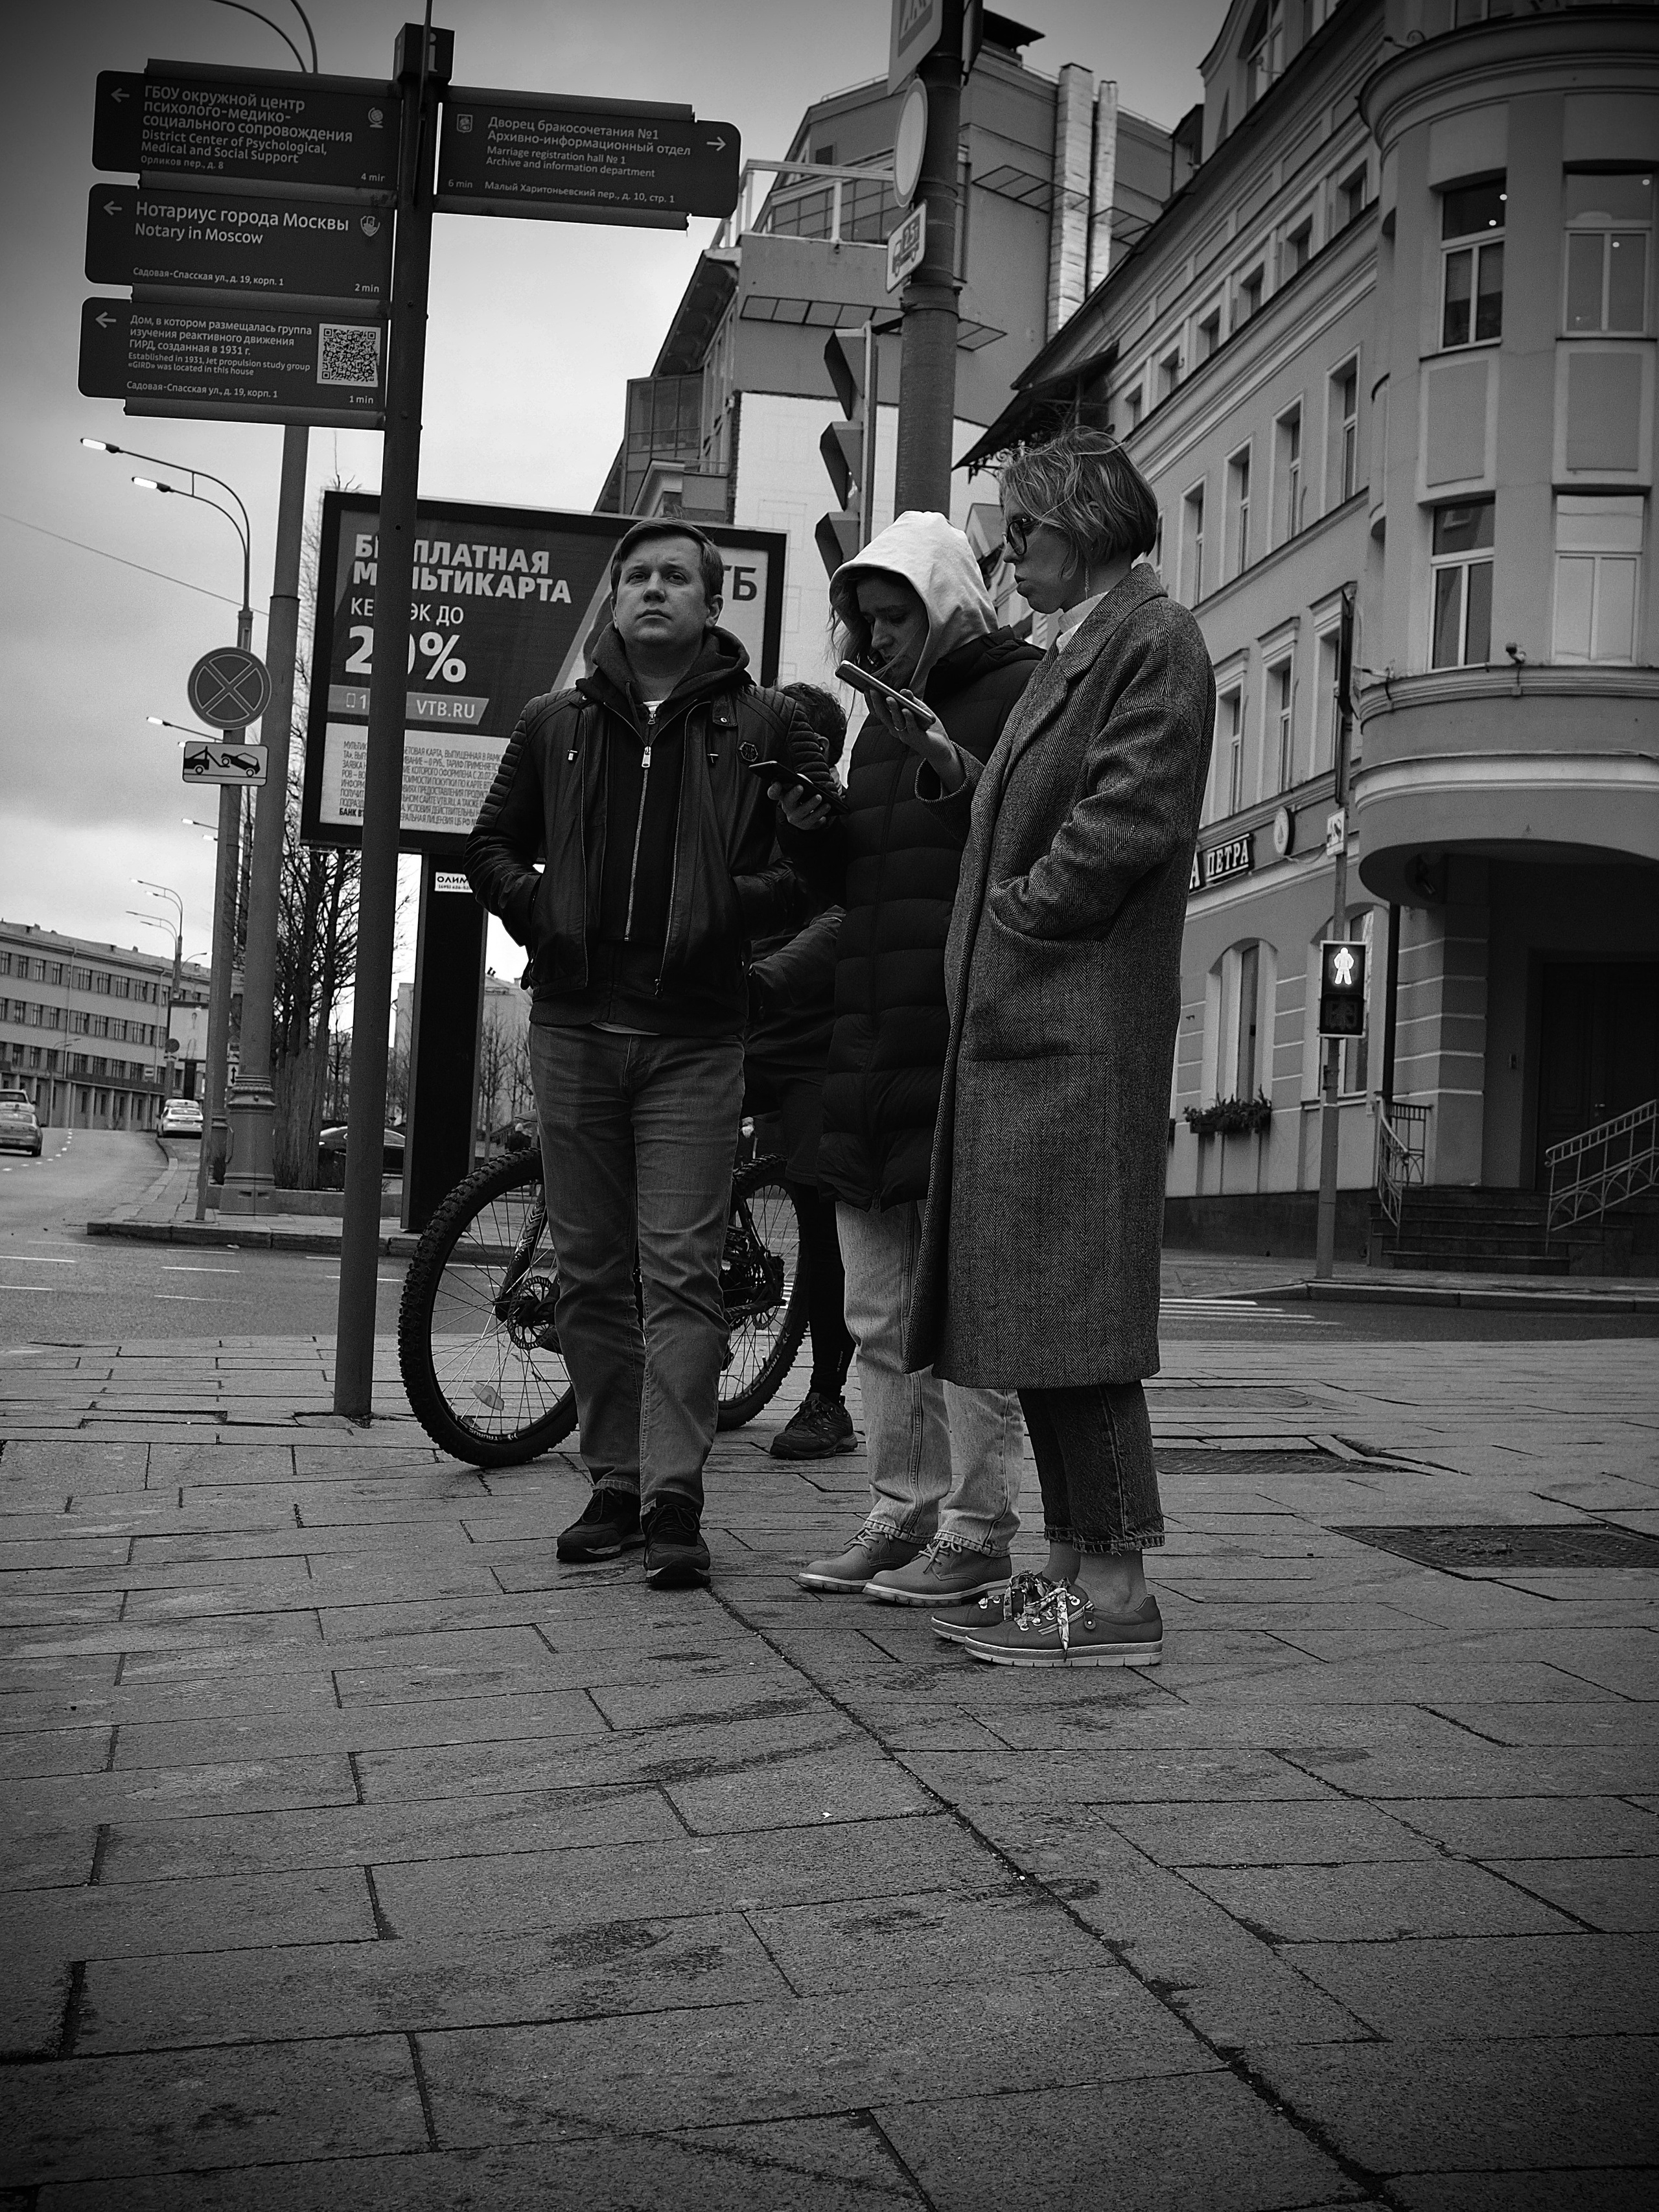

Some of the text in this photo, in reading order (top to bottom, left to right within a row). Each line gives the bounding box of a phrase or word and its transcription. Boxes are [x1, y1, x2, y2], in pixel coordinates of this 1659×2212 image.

[145, 85, 305, 113] ГБОУ окружной центр
[144, 101, 291, 122] психолого-медико-
[143, 115, 353, 143] социального сопровождения
[488, 117, 659, 140] Дворец бракосочетания №1
[141, 141, 299, 163] Medical and Social Support
[142, 130, 327, 156] District Center of Psychological,
[487, 130, 691, 156] Архивно-информационный отдел
[141, 155, 181, 167] Орликов
[183, 159, 205, 169] пер.,
[207, 161, 216, 170] д.
[487, 145, 626, 165] Marriage registration hall № 1
[486, 156, 656, 178] Archive and information department
[448, 179, 473, 189] 6 min
[484, 181, 518, 191] Малый
[520, 183, 596, 197] Харитоньевский
[597, 191, 620, 200] пер.,
[634, 192, 647, 202] 10,
[649, 194, 666, 204] стр.
[135, 201, 349, 231] Нотариус города Москвы
[135, 222, 264, 244] Notary in Moscow
[133, 267, 213, 281] Садовая-Спасская
[214, 274, 229, 283] ул.,
[240, 275, 252, 285] 19,
[253, 277, 277, 286] корп.
[362, 284, 380, 293] min
[130, 314, 312, 336] Дом, в котором размещалась группа
[130, 328, 294, 346] изучения реактивного движения
[157, 342, 210, 353] созданная
[220, 345, 242, 355] 1931
[244, 347, 251, 356] г.
[128, 351, 310, 372] Established in 1931, Jet propulsion study group
[128, 361, 156, 369] «GIRD»
[174, 363, 203, 373] located
[204, 365, 212, 373] in
[213, 366, 229, 374] this
[230, 367, 254, 376] house
[126, 380, 207, 393] Садовая-Спасская
[208, 386, 223, 396] ул.,
[234, 388, 246, 397] 19,
[247, 390, 271, 399] корп.
[349, 395, 374, 404] 1 min
[355, 533, 550, 574] БПЛАТНАЯ
[353, 560, 572, 603] МЬТИКАРТА
[351, 597, 465, 627] КЕЭК ДО
[416, 699, 476, 718] VTB.RU
[343, 741, 367, 751] МУЛЬТИК
[403, 775, 432, 785] ТОИМОСТИ
[339, 808, 356, 817] БАНК
[1207, 839, 1249, 876] ПЕТРА
